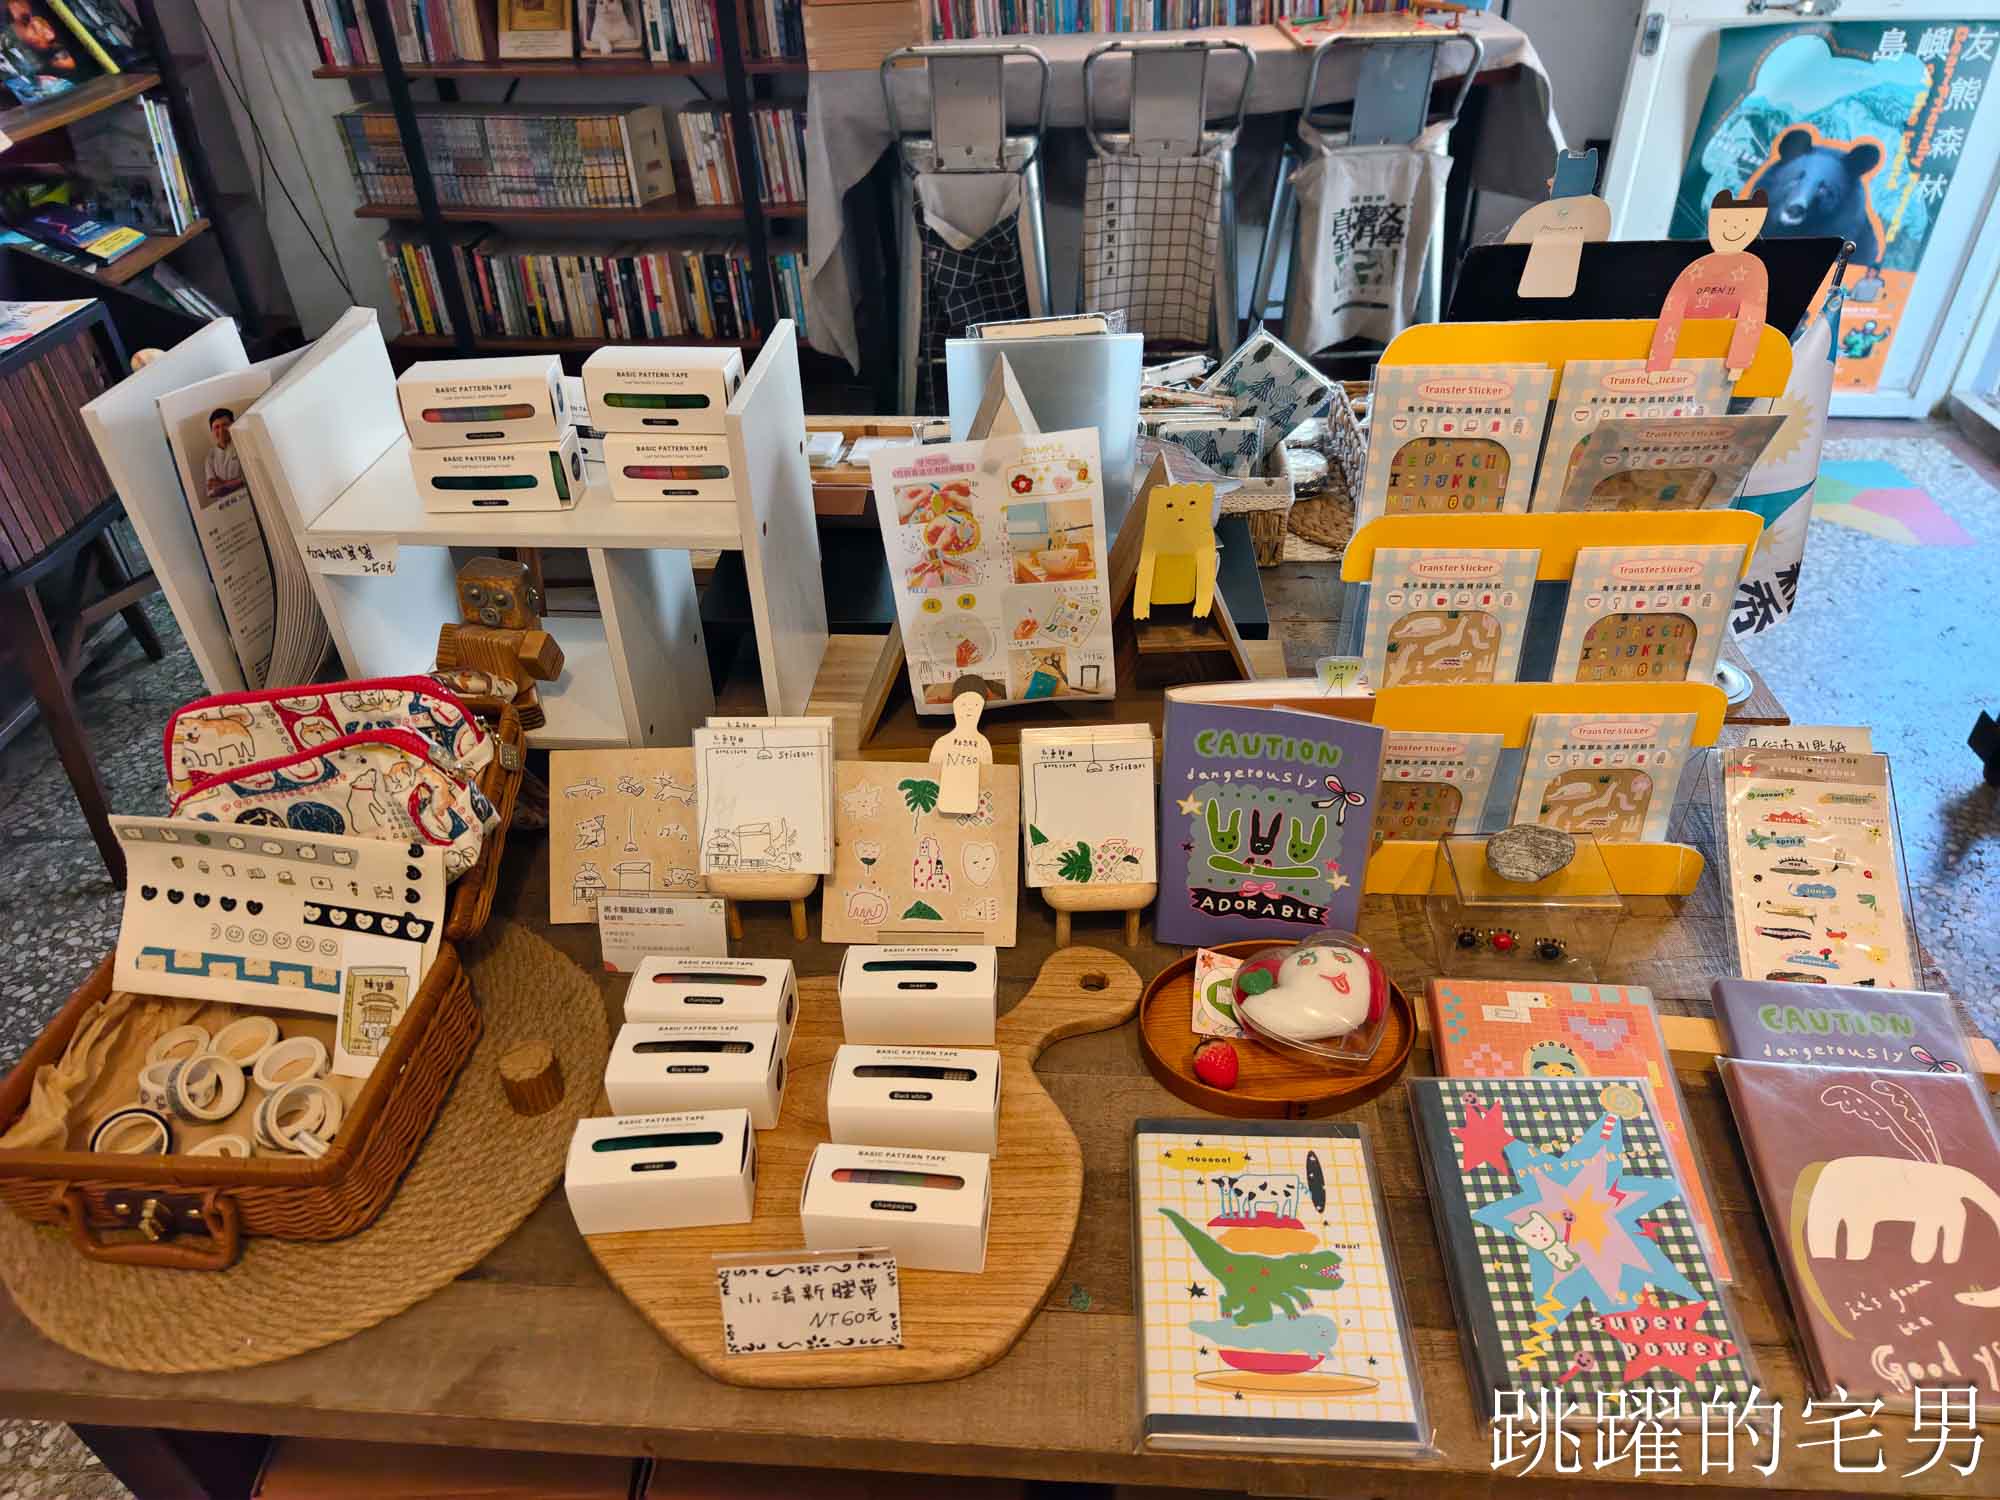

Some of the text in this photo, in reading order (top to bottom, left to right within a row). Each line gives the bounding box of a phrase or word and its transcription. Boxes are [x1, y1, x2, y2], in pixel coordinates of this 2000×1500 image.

[435, 386, 457, 394] BASIC
[1424, 385, 1504, 396] Transfer Sticker
[1418, 562, 1494, 574] Transfer Sticker
[1619, 564, 1696, 575] Transfer Sticker
[1578, 727, 1650, 736] Transfer Sticker
[1195, 730, 1342, 766] CAUTION
[1386, 743, 1457, 753] ransfer Sticker
[1187, 767, 1317, 788] dangerously
[1200, 896, 1319, 919] ADORABLE
[1759, 1005, 1914, 1037] CAUTION
[1763, 1043, 1904, 1063] dangerously
[885, 1151, 922, 1159] PATTERN
[738, 1278, 878, 1304] 小清新膠帶
[809, 1307, 882, 1328] NT60元
[1590, 1314, 1689, 1336] super
[1623, 1338, 1731, 1362] power
[1871, 1339, 1962, 1393] Good
